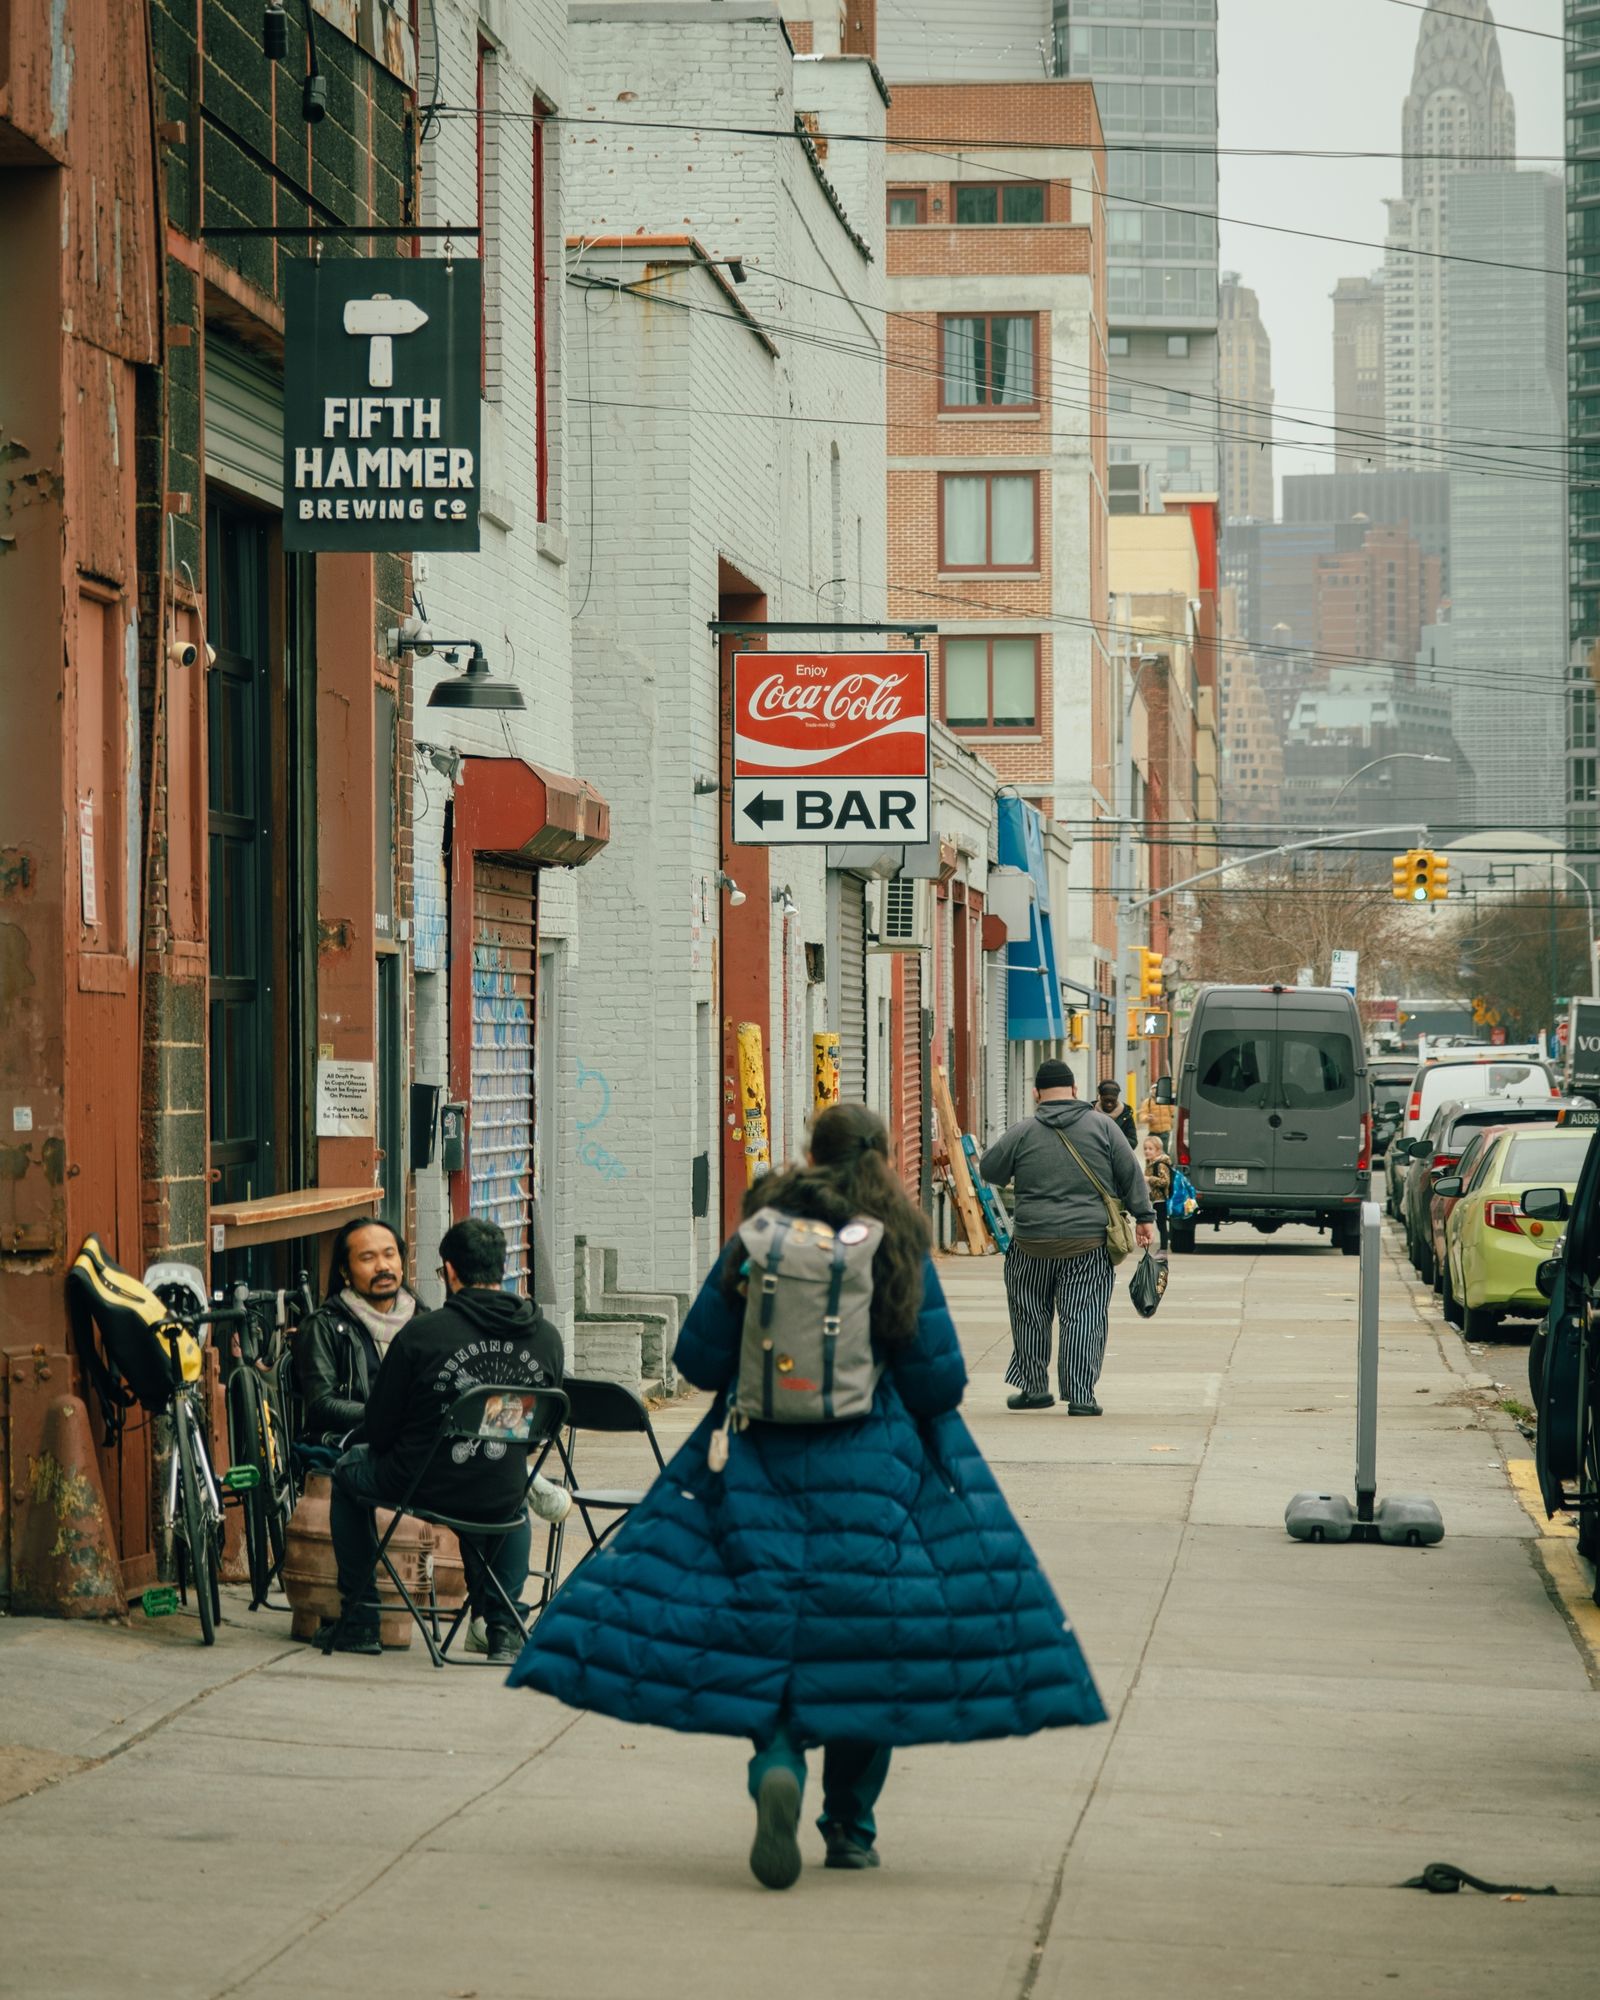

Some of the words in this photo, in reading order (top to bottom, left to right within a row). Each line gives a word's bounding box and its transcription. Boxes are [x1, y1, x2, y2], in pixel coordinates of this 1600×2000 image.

[323, 397, 441, 438] FIFTH
[295, 447, 475, 488] HAMMER
[299, 499, 424, 520] BREWING
[795, 664, 828, 677] Enjoy
[748, 673, 909, 721] Coca-Cola
[796, 790, 917, 830] BAR
[433, 1340, 514, 1392] BOUNCING
